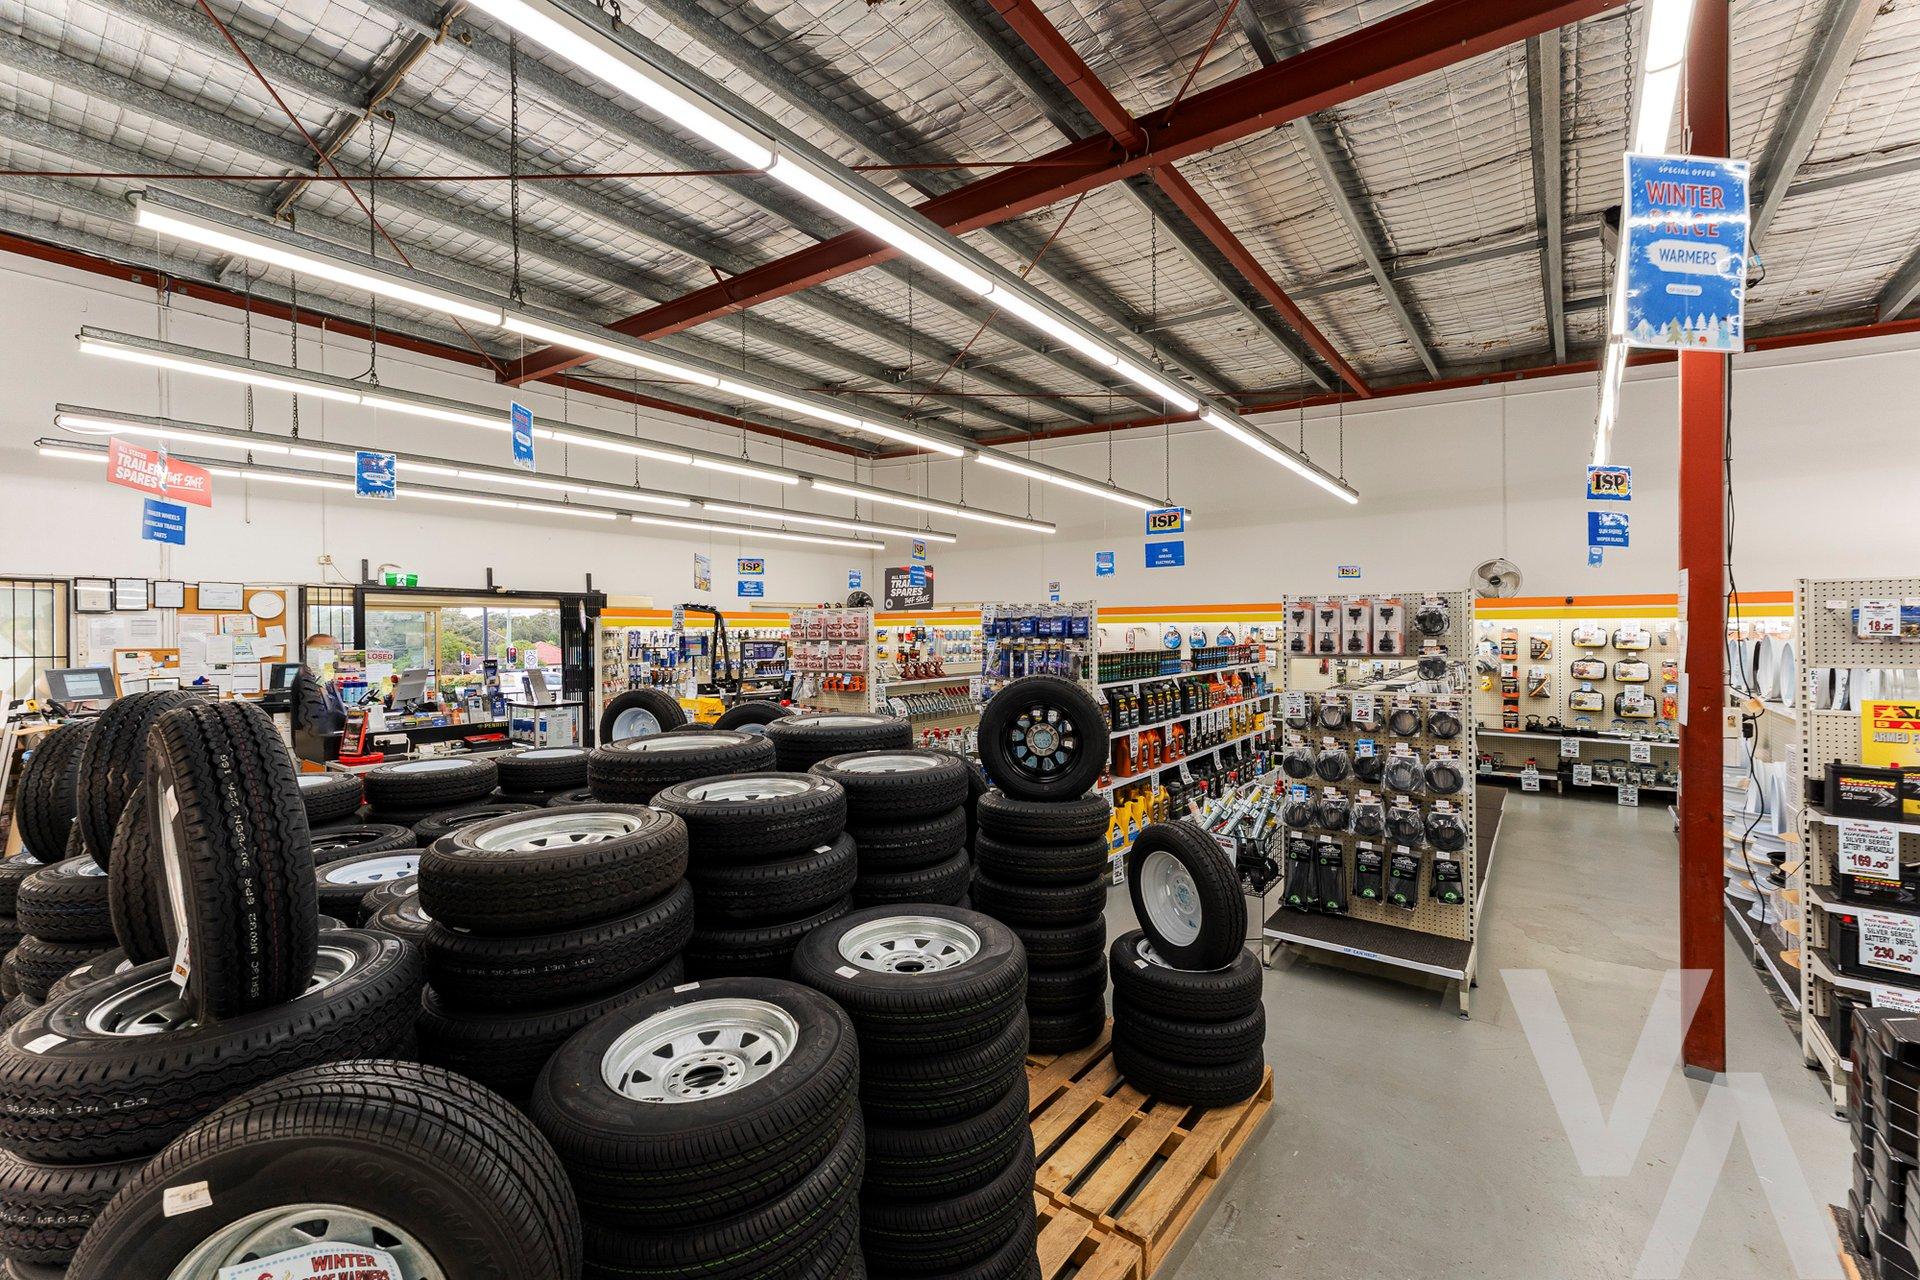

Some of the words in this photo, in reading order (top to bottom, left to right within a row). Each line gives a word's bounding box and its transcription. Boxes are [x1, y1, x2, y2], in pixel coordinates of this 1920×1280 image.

[1658, 166, 1690, 176] SPECIAL
[1691, 169, 1717, 177] OFFER
[1645, 179, 1725, 209] WINTER
[1650, 210, 1721, 239] PRICE
[1659, 248, 1717, 266] WARMERS
[117, 452, 161, 478] TRAILER
[115, 466, 159, 489] SPARES
[1595, 473, 1625, 491] ISP
[1151, 514, 1178, 528] ISP
[914, 543, 924, 554] ISP
[742, 562, 761, 572] ISP
[891, 579, 910, 589] TRAI
[890, 587, 924, 597] SPARES
[1868, 620, 1894, 631] 18.95
[1873, 732, 1909, 743] ARMED
[1845, 836, 1866, 844] SILVER
[1868, 839, 1891, 847] SERIES
[1866, 927, 1888, 936] SILVER
[1890, 930, 1913, 939] SERIES
[1864, 934, 1891, 944] BATTERY
[311, 1253, 378, 1273] WINTER
[337, 1269, 391, 1280] WARMERS
